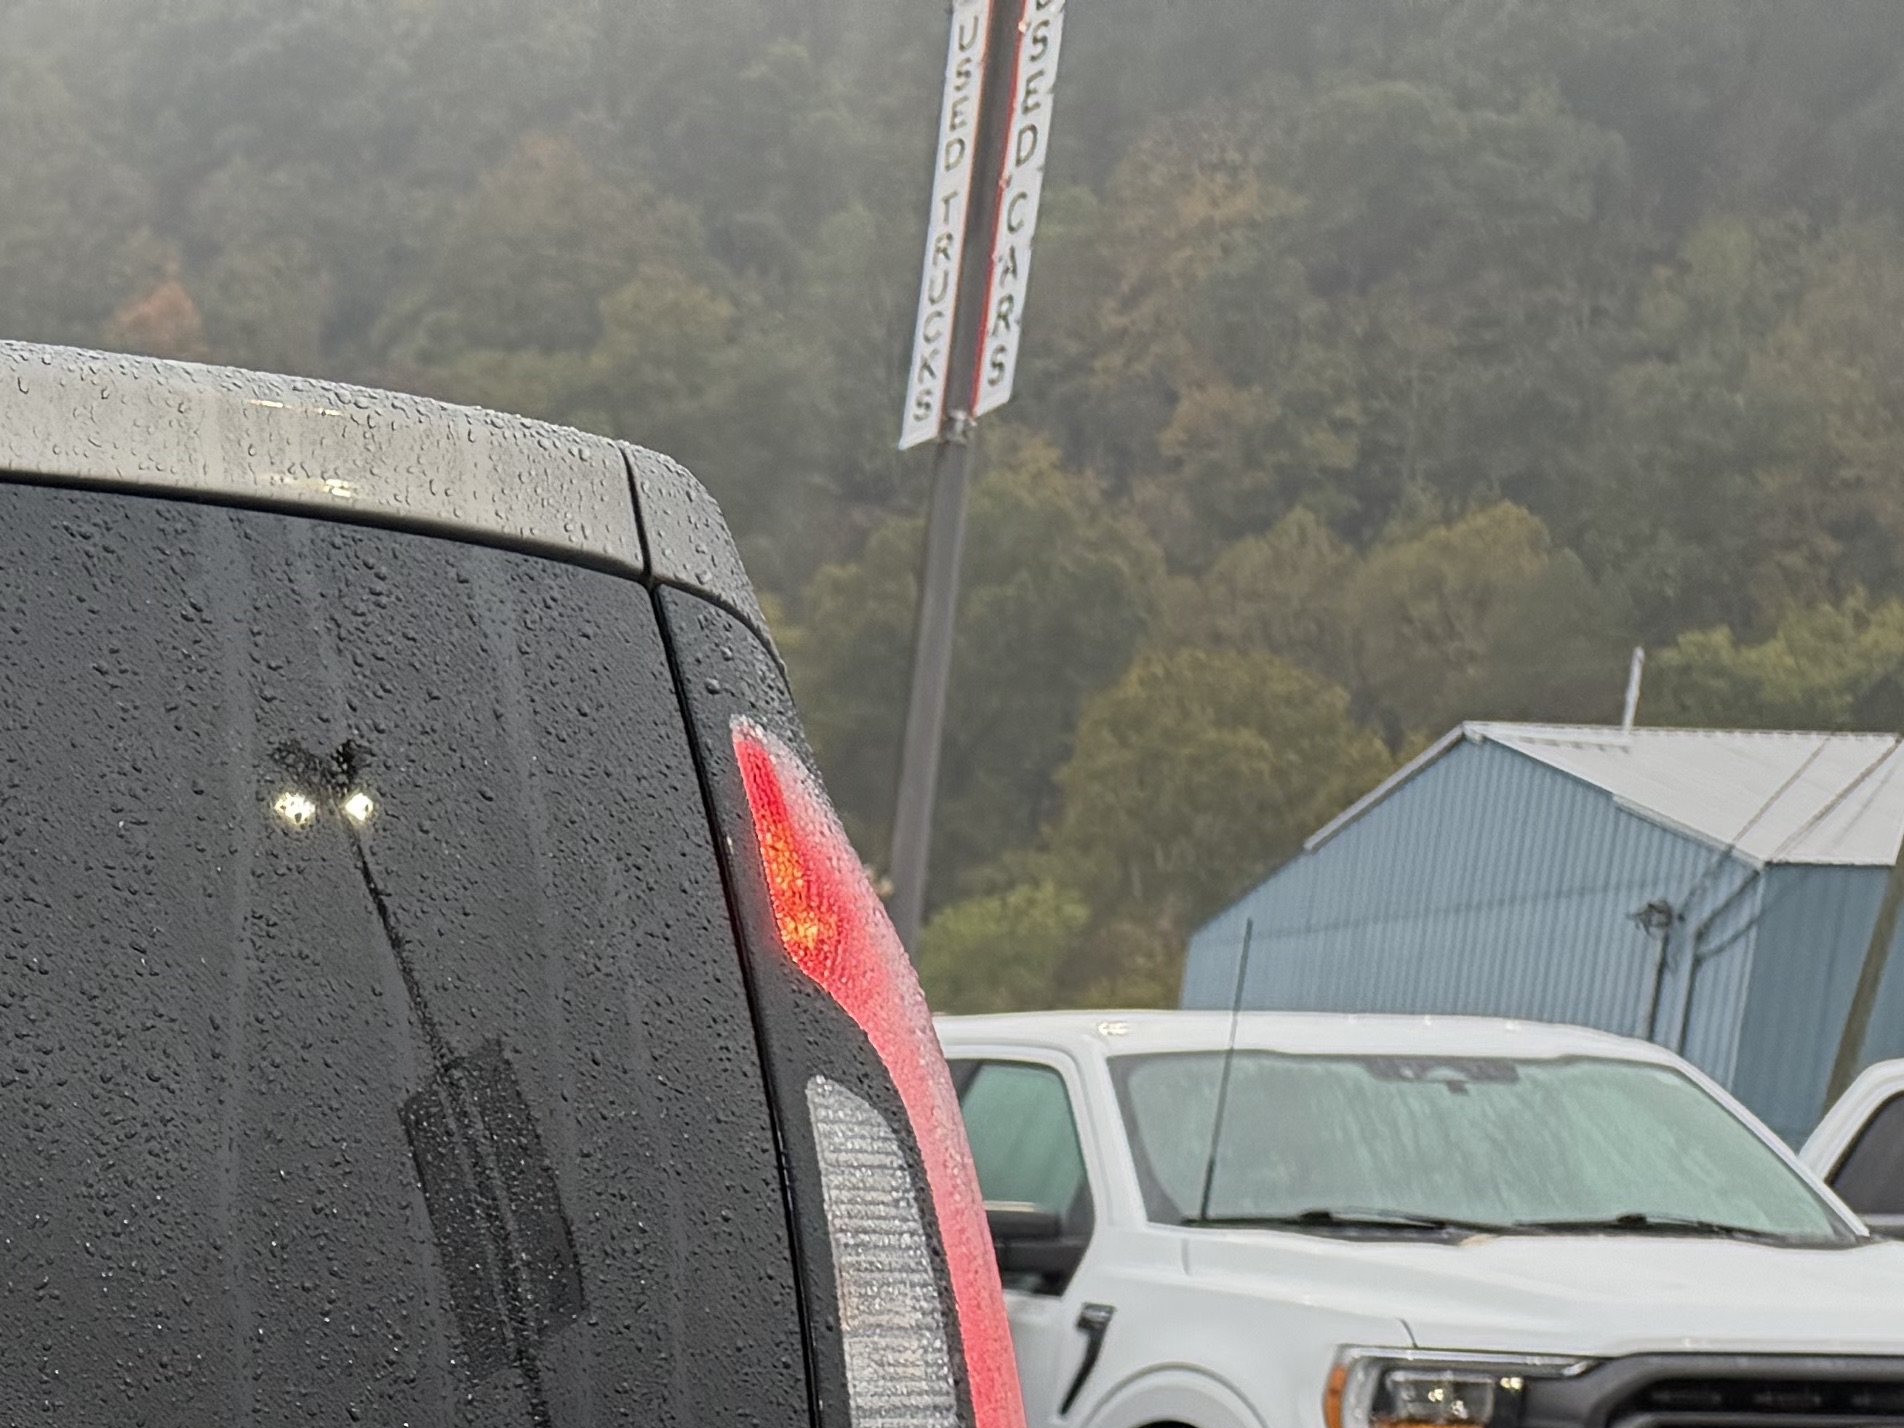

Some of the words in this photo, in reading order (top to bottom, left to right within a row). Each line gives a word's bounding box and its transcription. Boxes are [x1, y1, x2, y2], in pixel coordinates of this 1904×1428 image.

[944, 14, 980, 173] USED
[1015, 0, 1053, 168] SED
[913, 189, 959, 423] TRUCKS
[987, 190, 1028, 387] CARS
